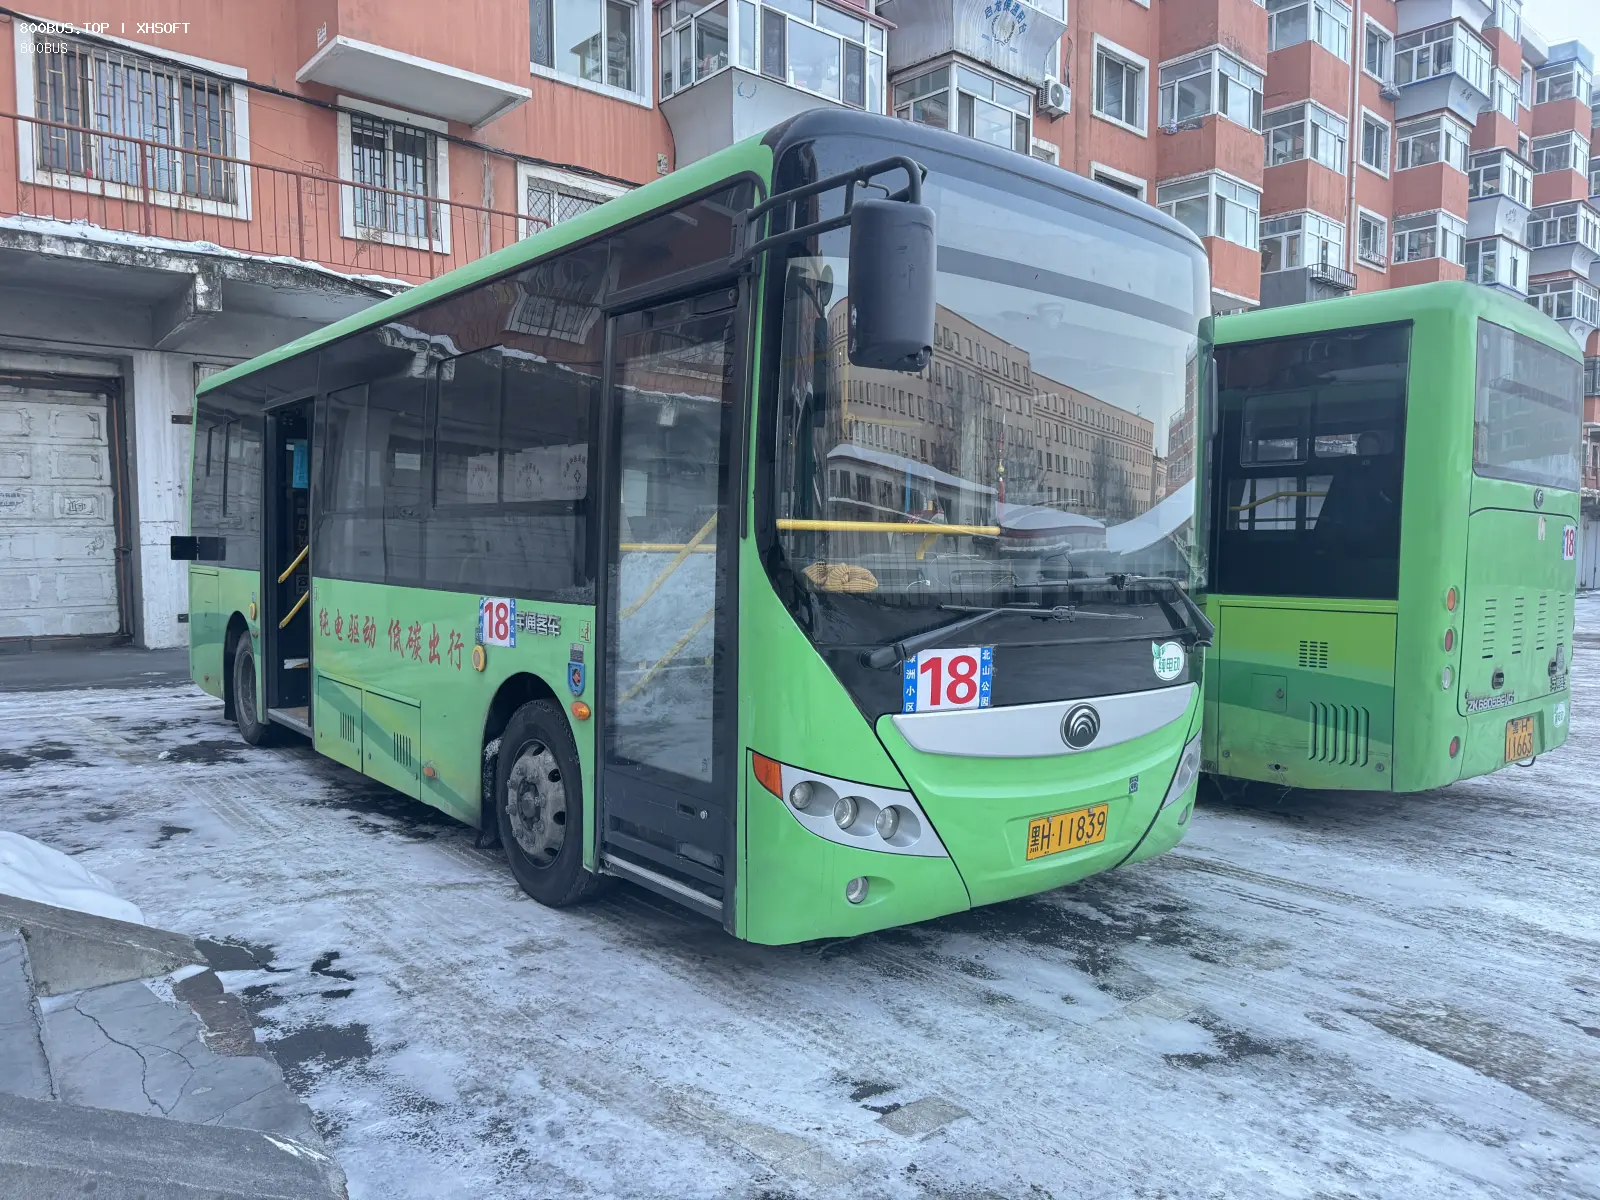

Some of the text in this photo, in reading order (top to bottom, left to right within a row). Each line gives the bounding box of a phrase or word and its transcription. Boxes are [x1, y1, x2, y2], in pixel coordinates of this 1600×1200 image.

[1565, 529, 1574, 556] 18
[319, 608, 376, 649] 纯电驱动
[388, 618, 464, 671] 低碳出行
[484, 601, 509, 640] 18
[920, 655, 978, 706] 18
[980, 649, 990, 707] 北山公园
[1508, 733, 1532, 760] 11663
